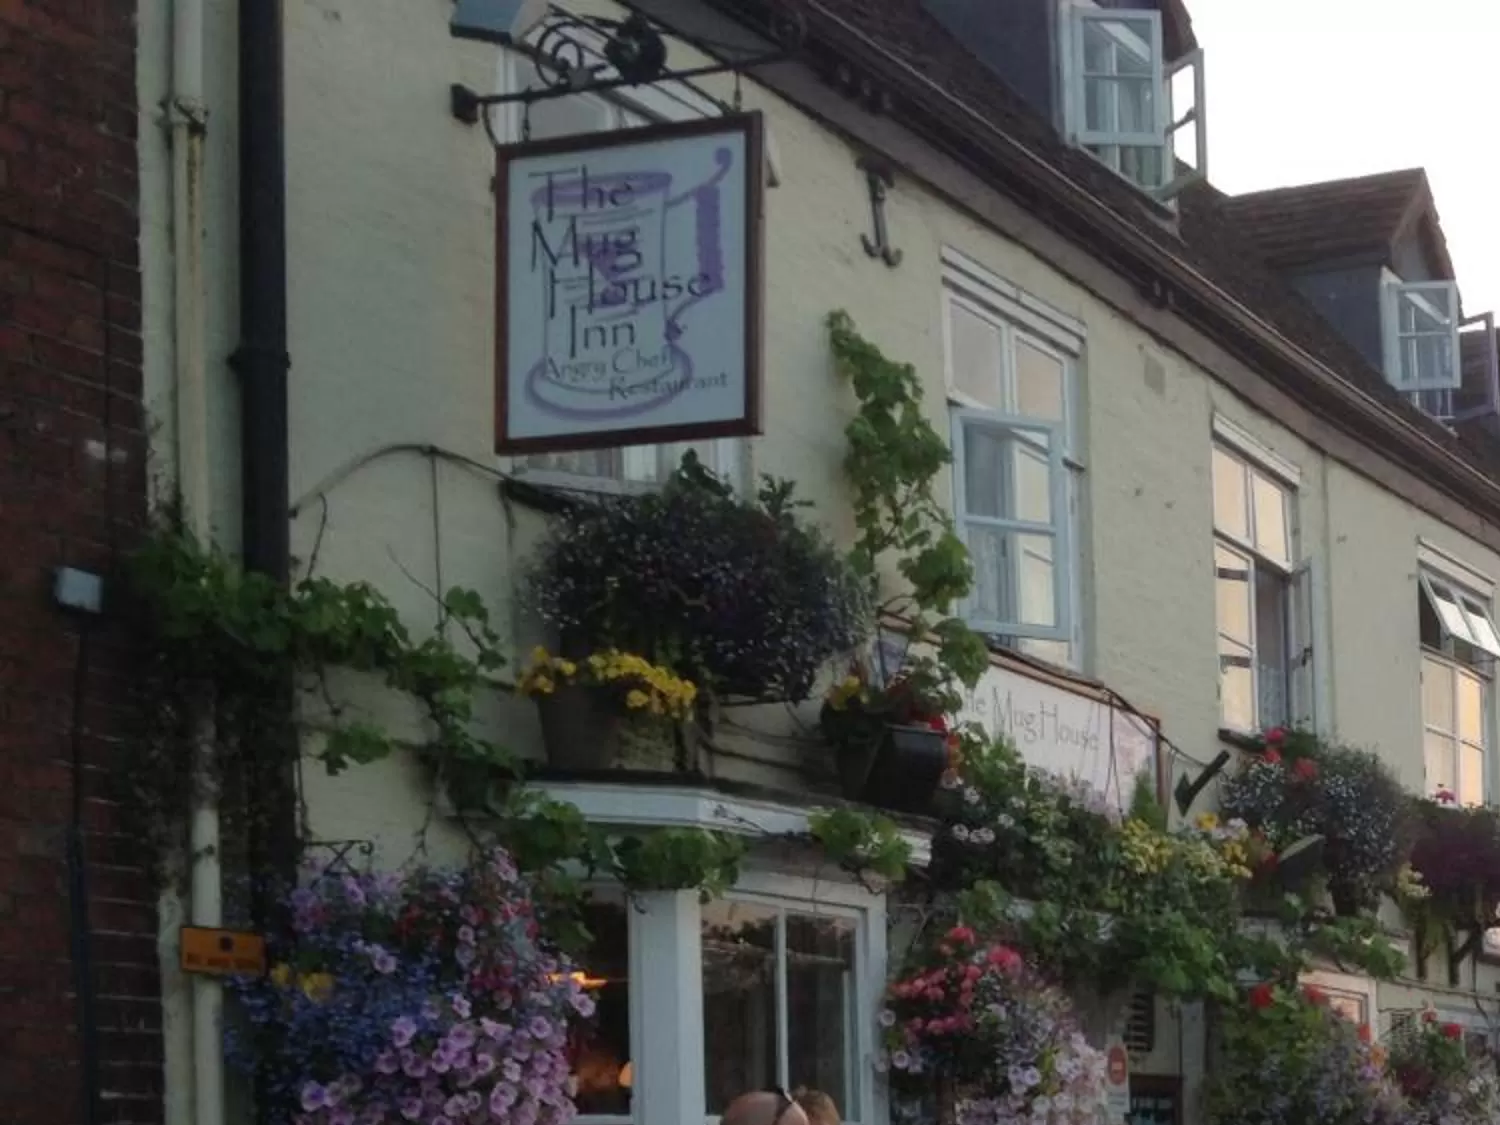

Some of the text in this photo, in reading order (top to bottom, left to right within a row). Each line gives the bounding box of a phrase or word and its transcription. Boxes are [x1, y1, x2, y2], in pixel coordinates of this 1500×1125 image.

[528, 164, 634, 222] The
[530, 215, 643, 272] Mug
[549, 260, 712, 319] House
[568, 304, 635, 358] Inn
[992, 686, 1037, 744] Mug
[1039, 699, 1098, 751] House
